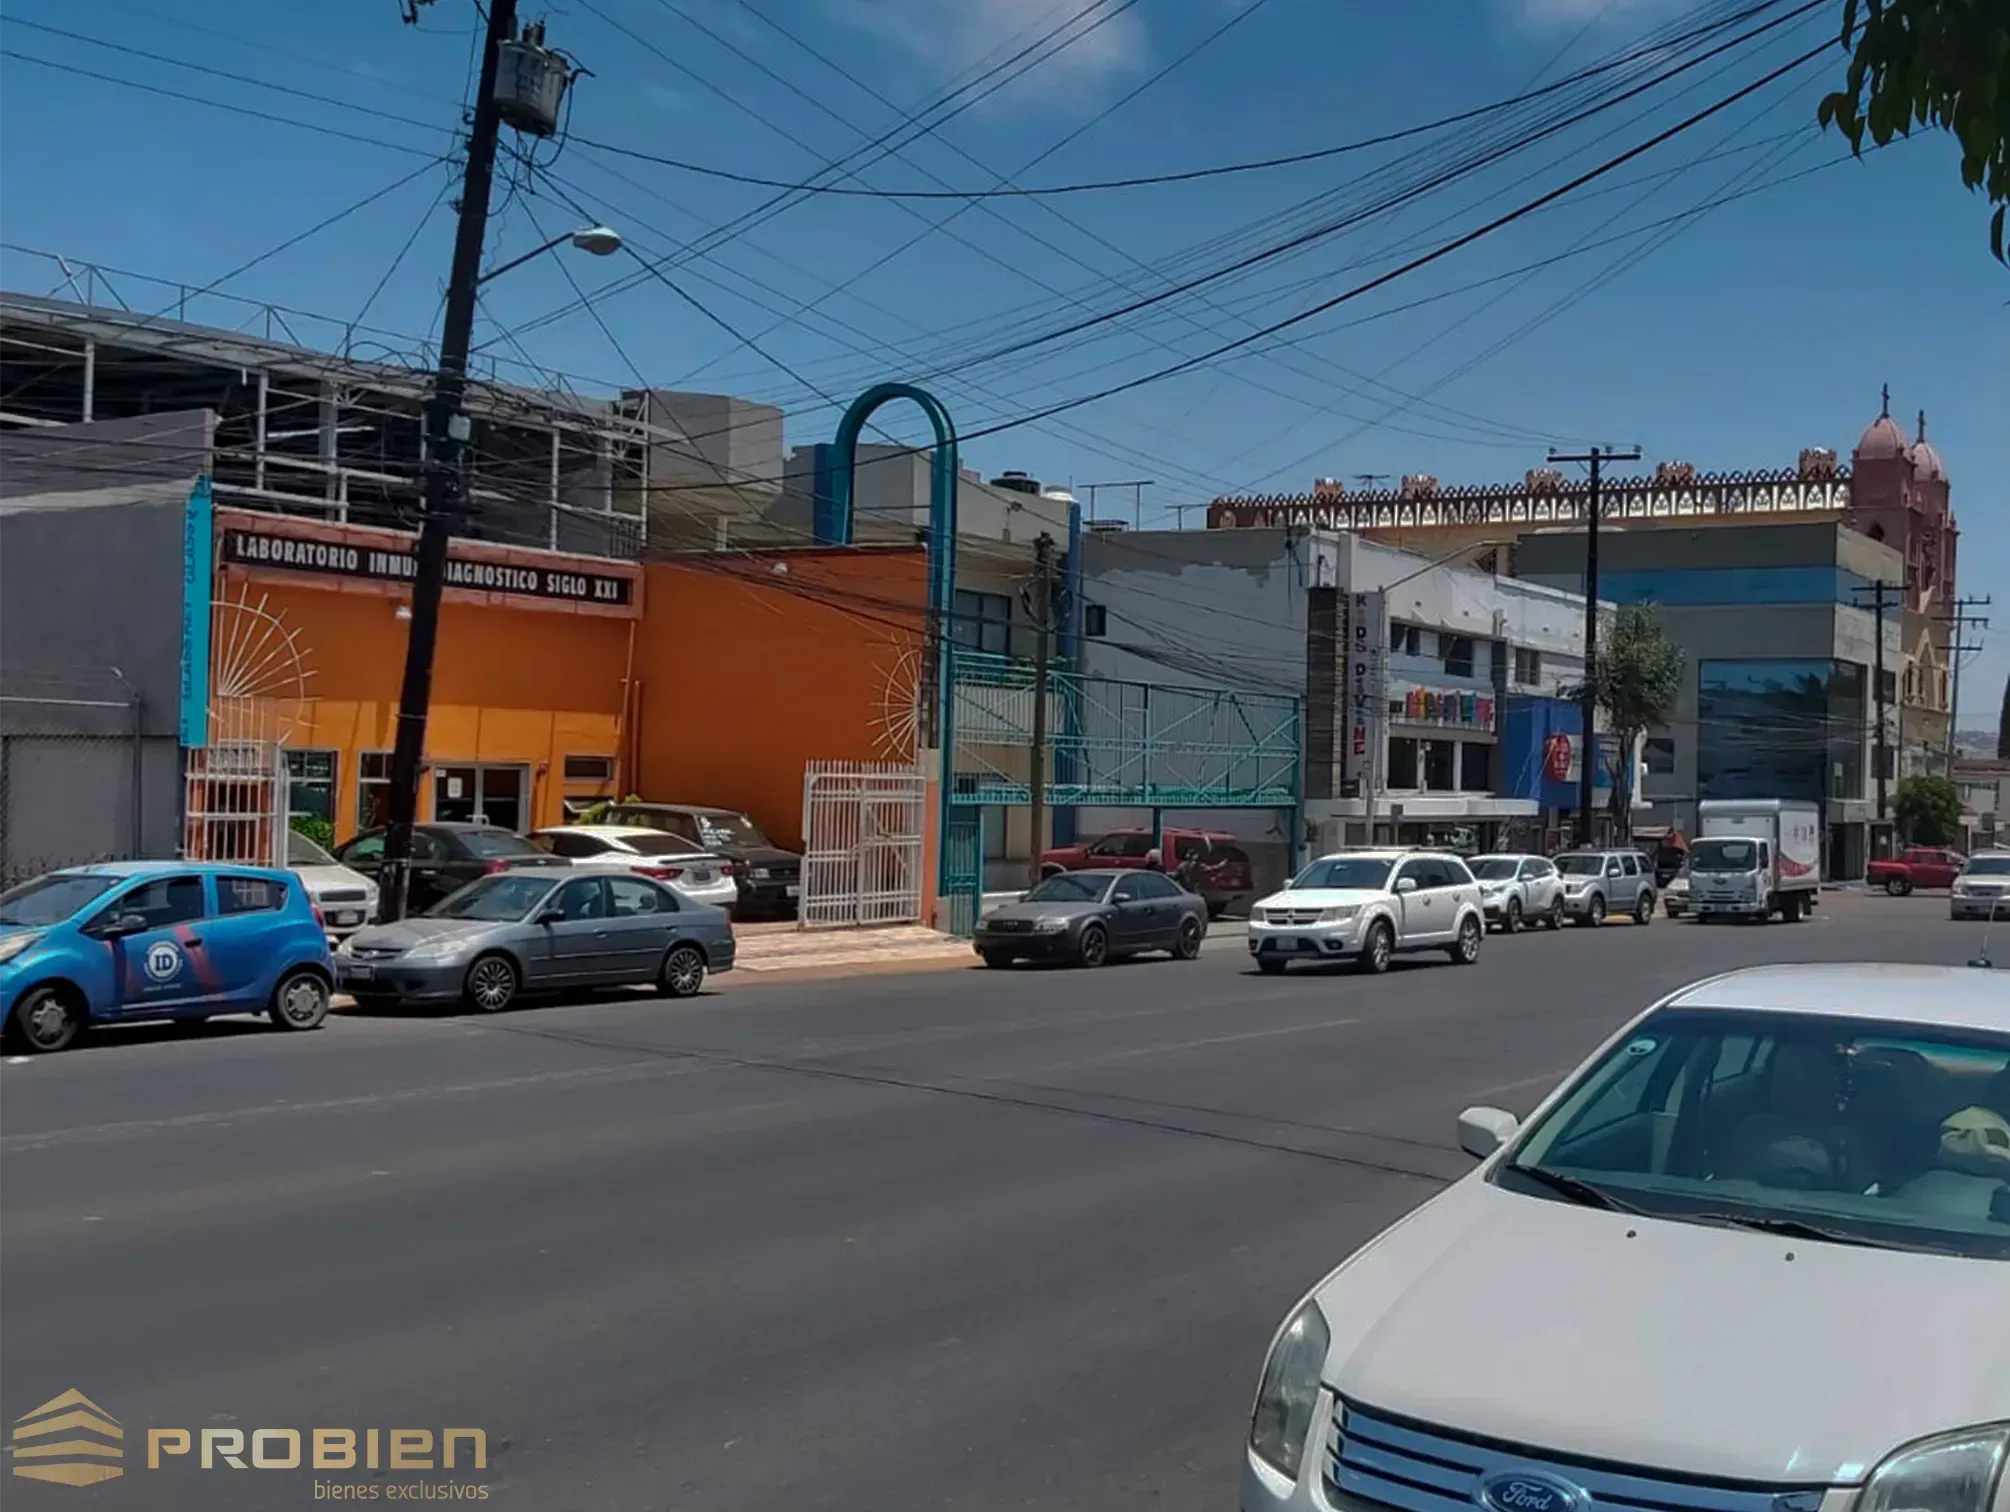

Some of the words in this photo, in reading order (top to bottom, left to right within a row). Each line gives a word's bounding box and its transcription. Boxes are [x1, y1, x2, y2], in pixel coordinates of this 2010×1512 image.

[236, 533, 359, 571] LABORATORIO
[547, 573, 587, 596] SIGLO
[594, 579, 618, 600] XXI
[155, 953, 174, 971] ID
[1502, 1481, 1554, 1511] Ford
